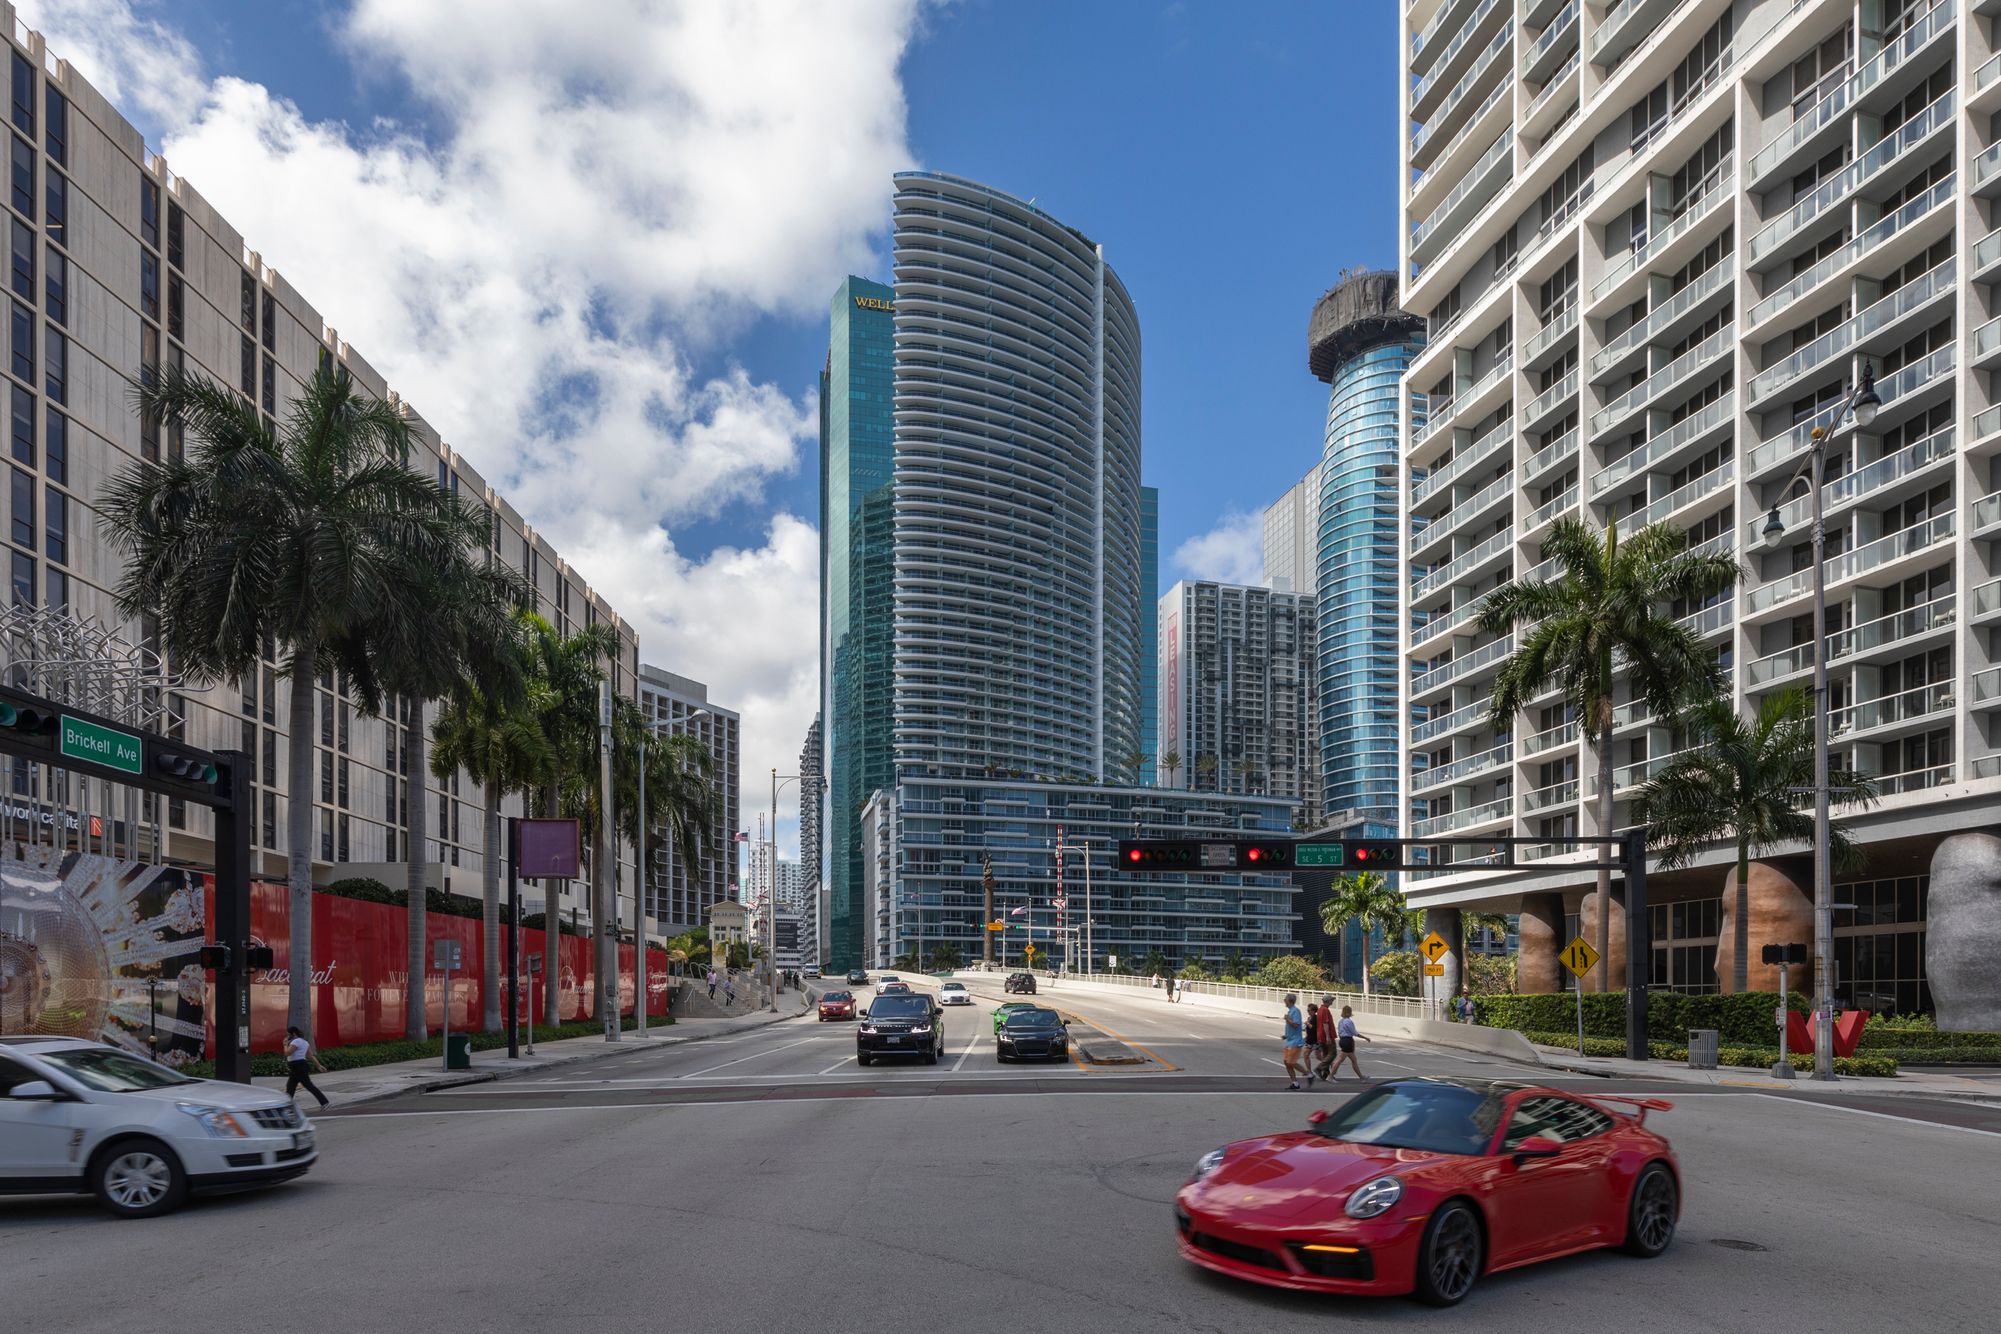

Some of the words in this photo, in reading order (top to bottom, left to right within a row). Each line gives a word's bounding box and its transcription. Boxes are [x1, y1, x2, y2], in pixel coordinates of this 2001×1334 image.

[855, 296, 896, 311] WELL
[66, 728, 110, 754] Brickell
[116, 743, 137, 762] Ave
[1317, 854, 1323, 864] 5
[1786, 1008, 1872, 1058] W
